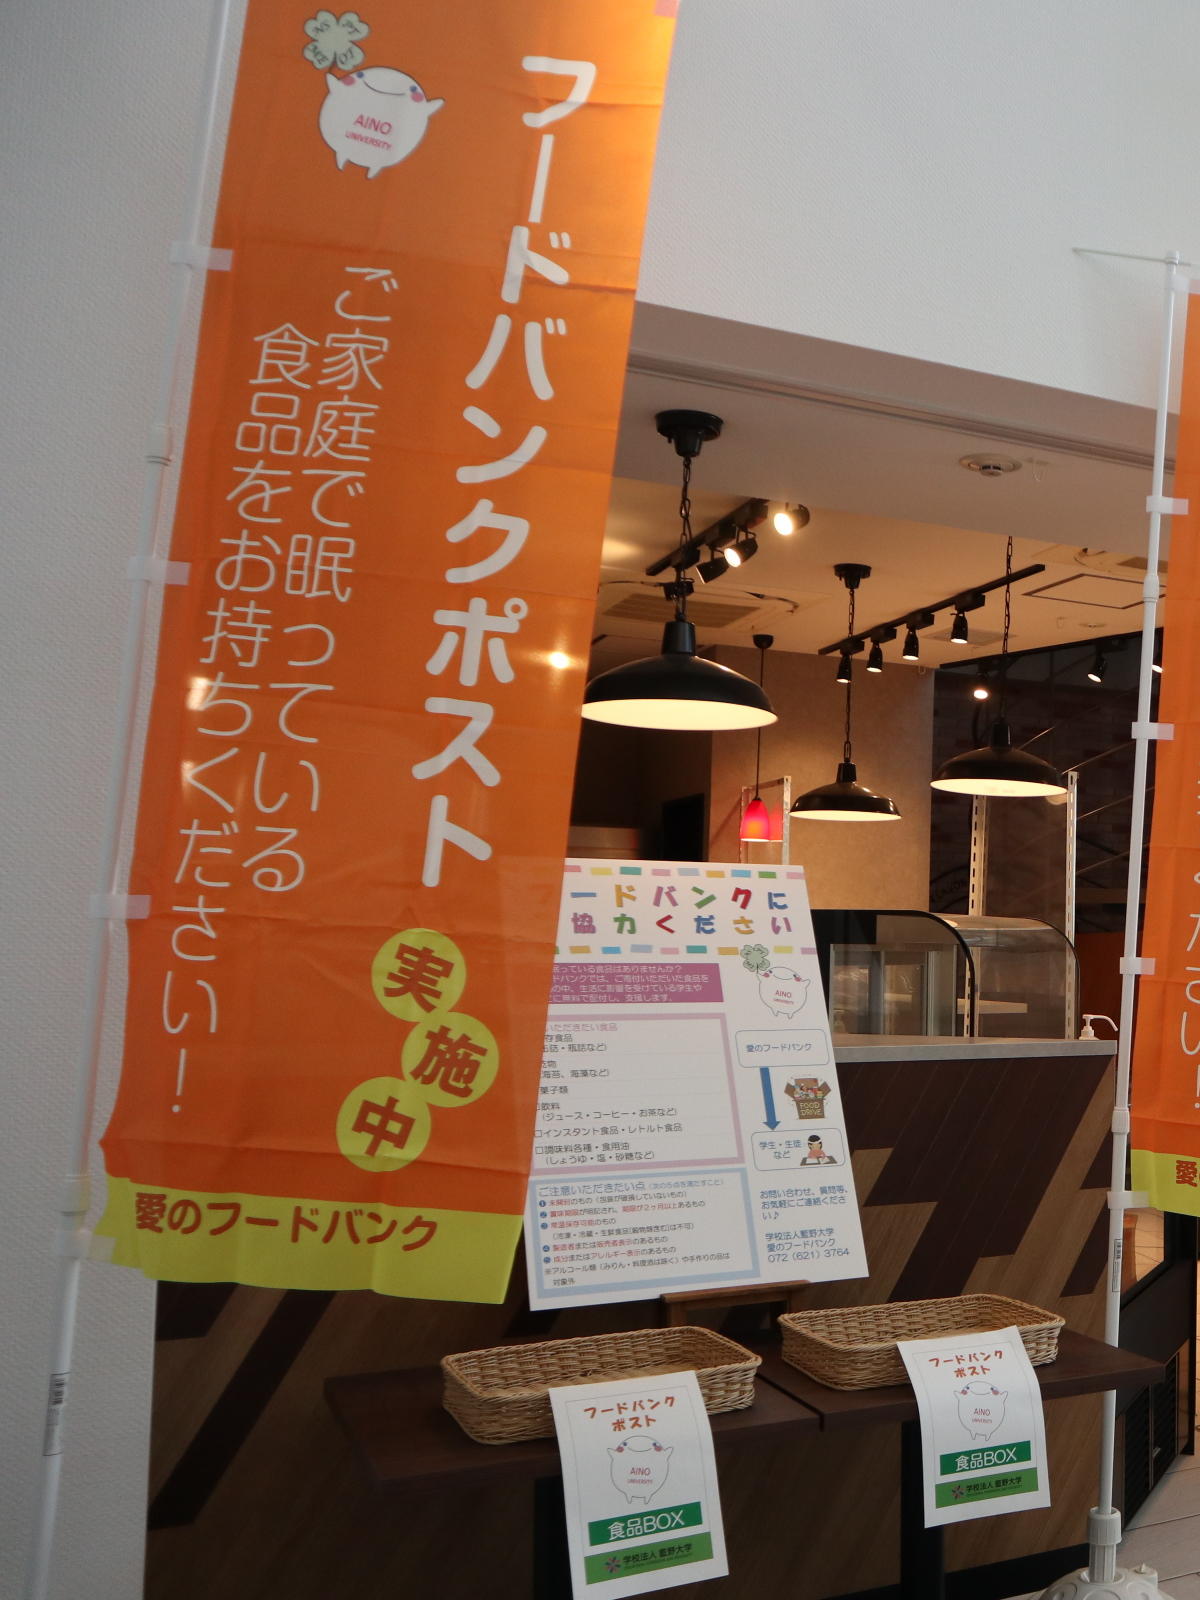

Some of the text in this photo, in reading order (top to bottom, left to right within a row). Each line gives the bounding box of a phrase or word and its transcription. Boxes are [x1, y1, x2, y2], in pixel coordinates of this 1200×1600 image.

[354, 114, 392, 135] AINO
[345, 131, 392, 150] UNIVERSITY
[412, 56, 597, 887] フードバンクポスト
[242, 267, 398, 891] ご家庭で眠っている
[162, 323, 320, 1113] 食品をお持ちください!
[775, 989, 792, 998] AINO
[352, 945, 488, 1158] 実施中
[135, 1192, 438, 1252] 愛のフードバンク
[767, 1238, 836, 1253] 愛のフードバンク
[928, 1350, 1003, 1367] フードバンク
[584, 1396, 675, 1419] フードバンク
[973, 1408, 991, 1416] AINO
[955, 1447, 1017, 1472] 食品BOX
[630, 1467, 652, 1477] AINO
[608, 1510, 685, 1541] 食品BOX
